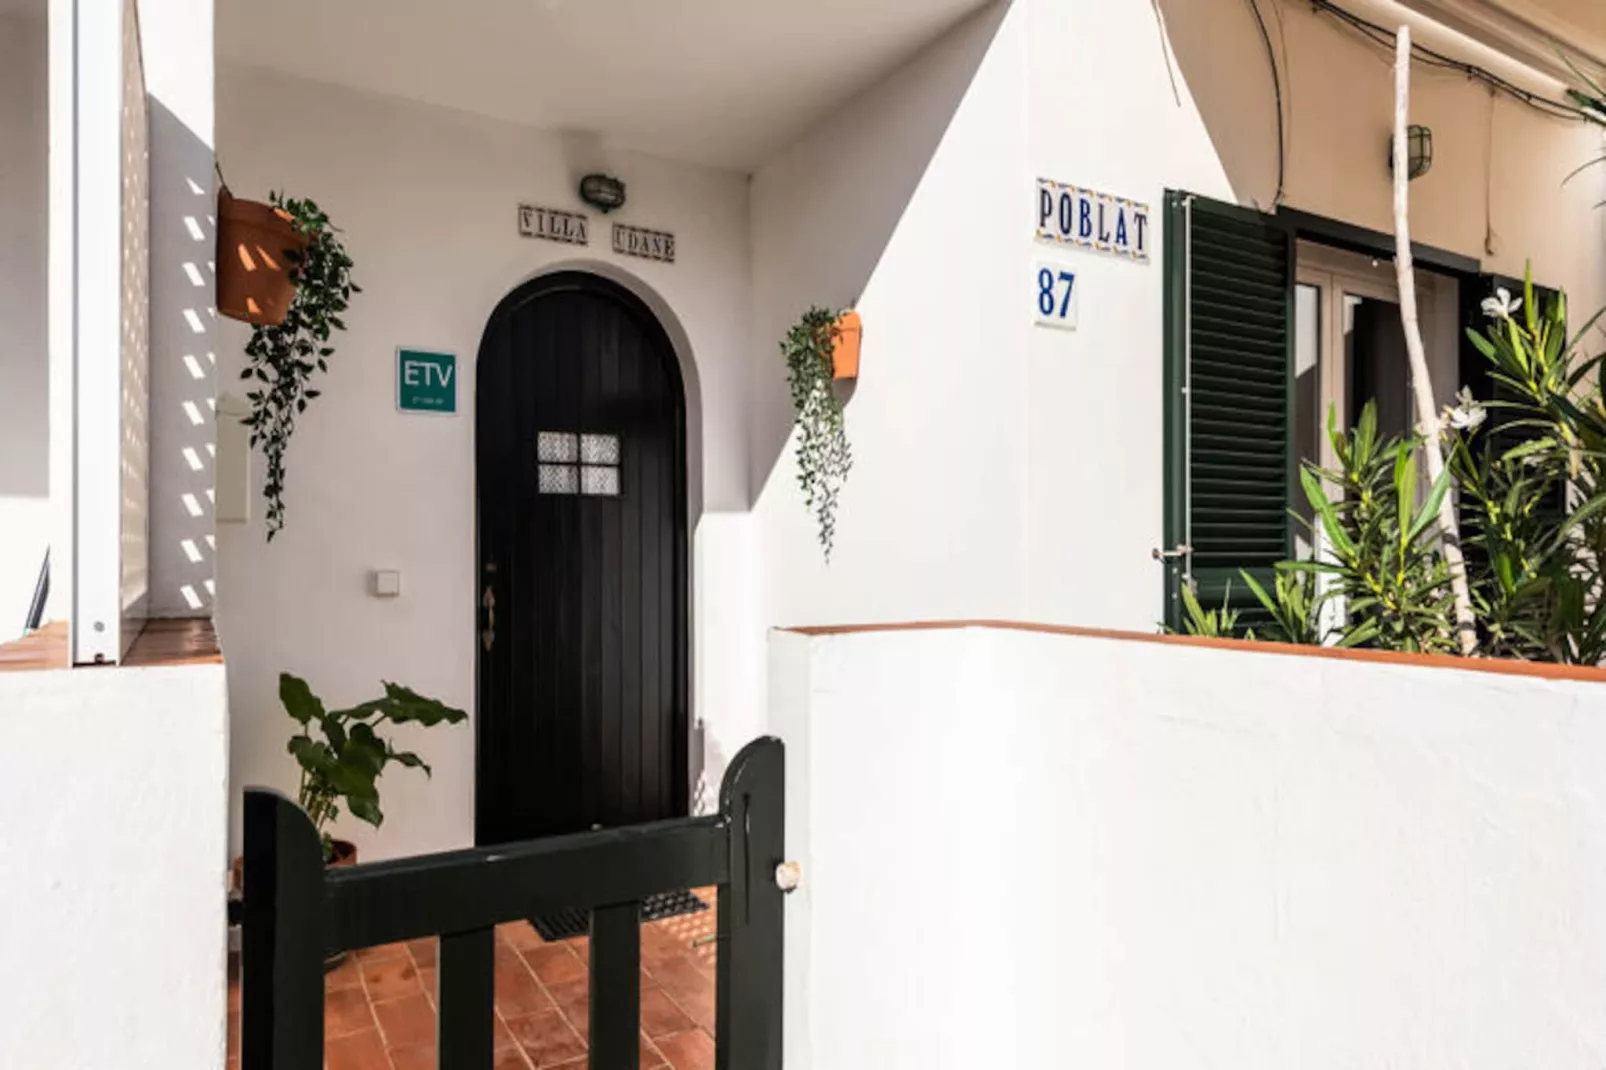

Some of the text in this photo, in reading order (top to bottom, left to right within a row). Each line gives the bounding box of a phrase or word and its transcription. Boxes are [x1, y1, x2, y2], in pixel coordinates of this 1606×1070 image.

[522, 210, 587, 239] VILLA
[1039, 187, 1147, 251] POBLAT
[1038, 268, 1075, 318] 87
[404, 360, 453, 388] ETV
